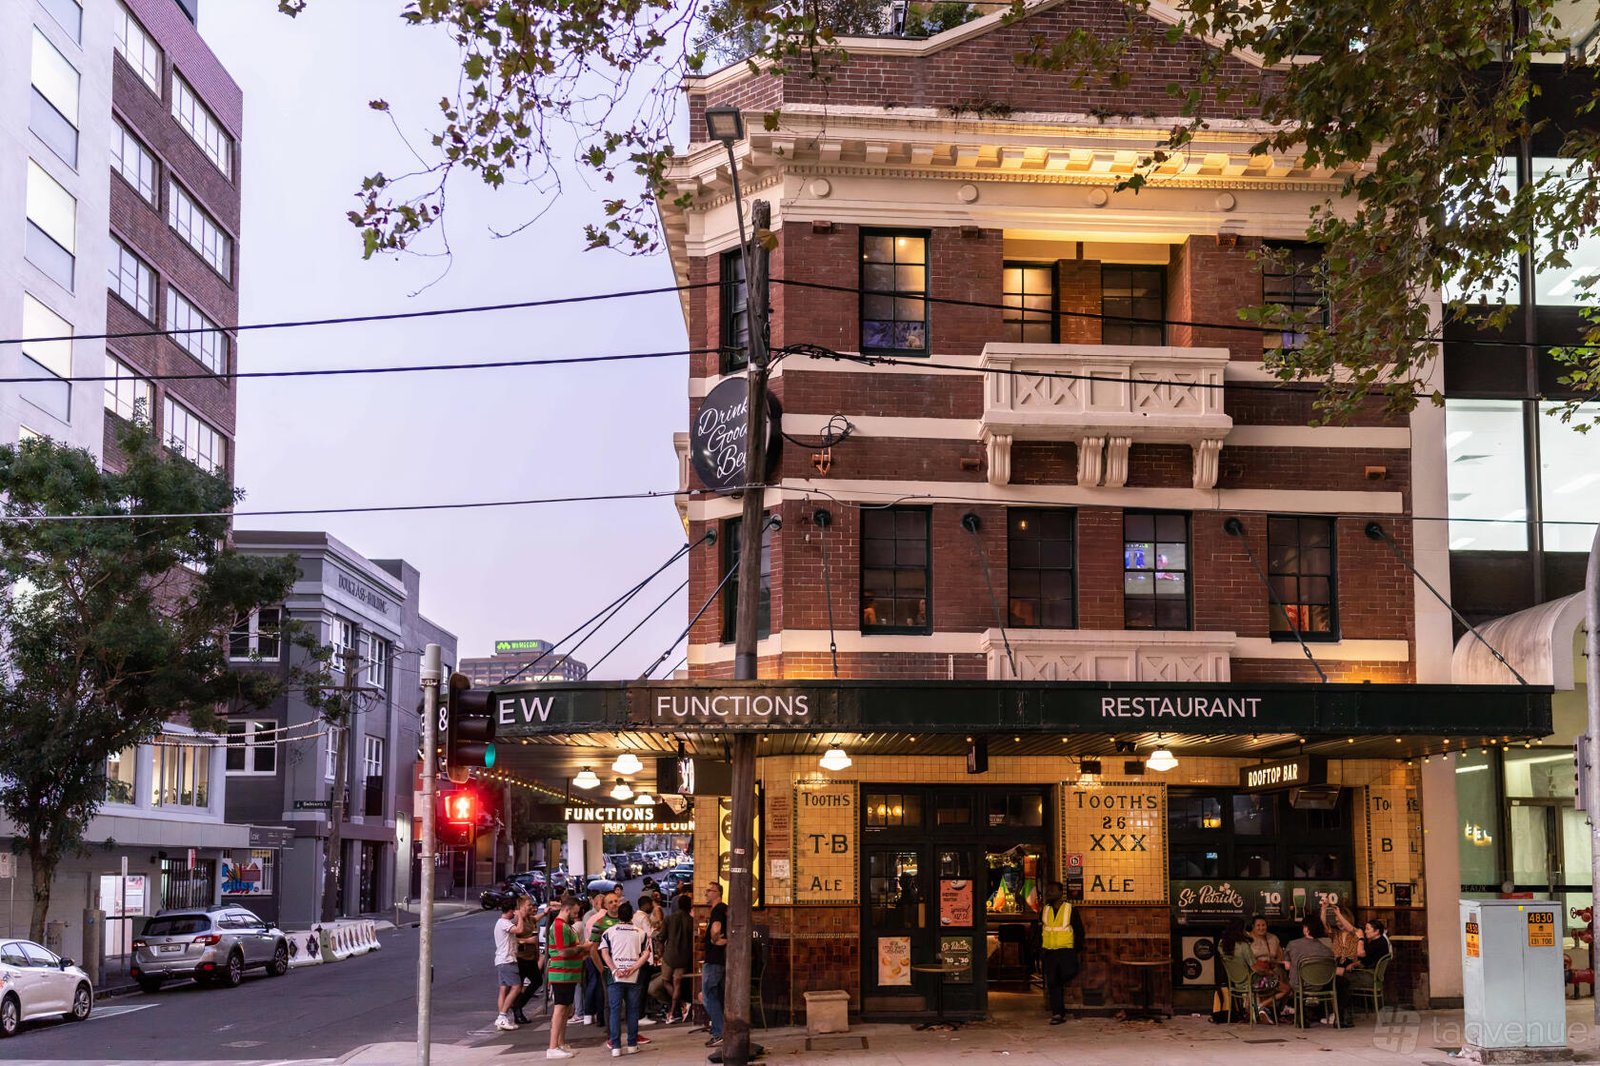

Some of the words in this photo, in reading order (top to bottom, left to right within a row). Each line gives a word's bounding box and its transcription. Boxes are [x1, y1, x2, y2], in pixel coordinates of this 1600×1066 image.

[698, 396, 748, 437] Drink
[499, 696, 555, 725] EW
[657, 695, 809, 717] FUNCTIONS
[1101, 697, 1262, 718] RESTAURANT
[1248, 766, 1281, 787] ROOFTOP
[1283, 763, 1298, 781] BAR
[564, 807, 655, 820] FUNCTIONS
[1102, 816, 1126, 830] 26
[1089, 834, 1147, 852] XXX
[1178, 888, 1196, 908] St
[1199, 885, 1244, 908] Patrick's
[1376, 879, 1418, 895] STT
[1529, 913, 1553, 923] 4830
